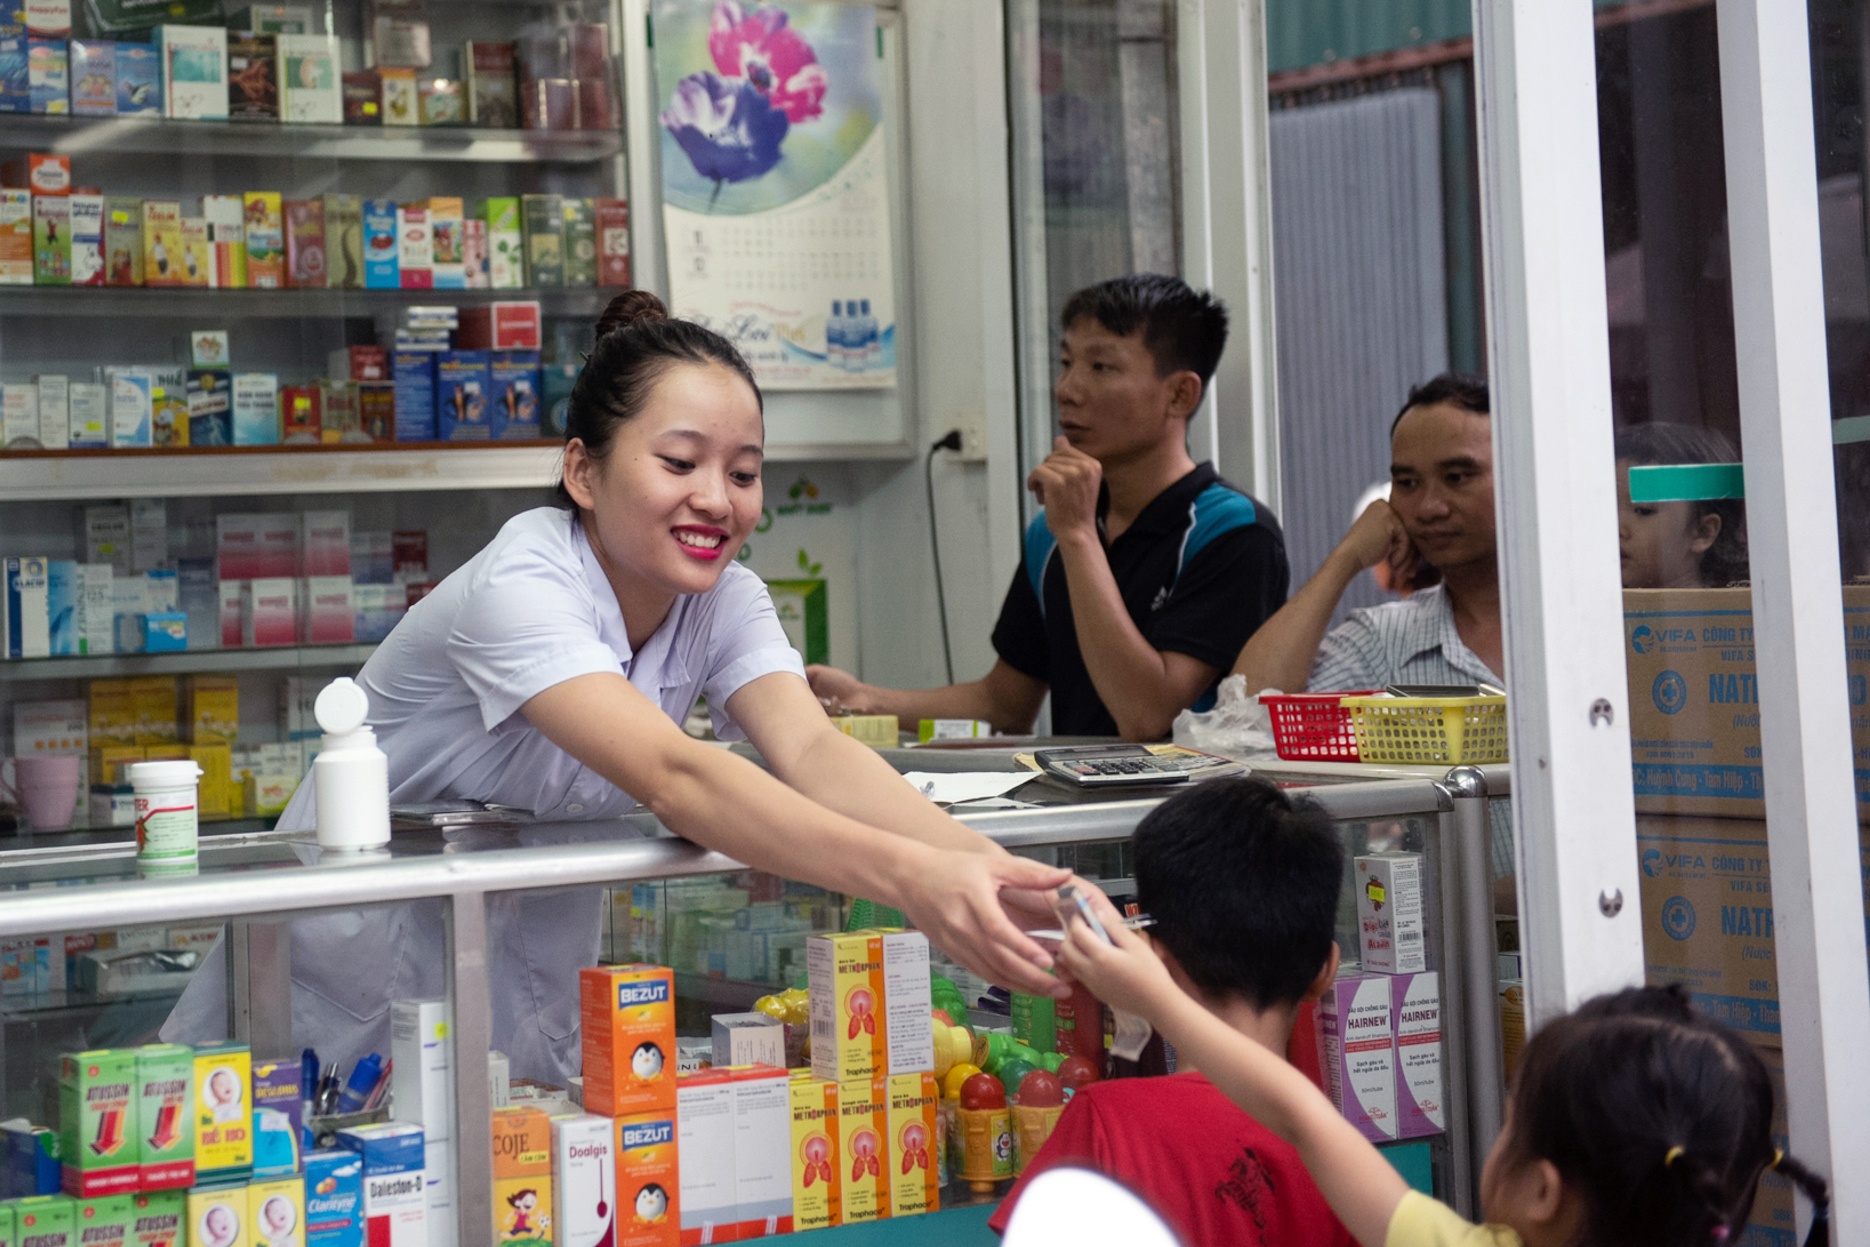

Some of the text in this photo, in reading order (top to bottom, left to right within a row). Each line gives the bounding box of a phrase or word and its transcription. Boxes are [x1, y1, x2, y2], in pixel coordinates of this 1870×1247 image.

[1655, 628, 1697, 643] VIFA
[1703, 626, 1736, 642] CÔNG
[1721, 649, 1744, 661] VIFA
[1665, 855, 1706, 868] VIFA
[1711, 854, 1763, 872] CÔNG TY
[1730, 880, 1753, 893] VIFA
[620, 985, 666, 1004] BEZUT
[1348, 1015, 1387, 1030] HAIRNEW
[1401, 1009, 1438, 1023] HAIRNEW
[624, 1126, 671, 1146] BEZUT
[493, 1132, 530, 1160] COJE
[569, 1144, 608, 1159] Doalgis
[370, 1175, 422, 1198] Daleston-D
[308, 1196, 357, 1214] Clarityne
[899, 1200, 931, 1212] Traphaco
[801, 1213, 835, 1225] Traphaco
[850, 1207, 883, 1219] Traphaco
